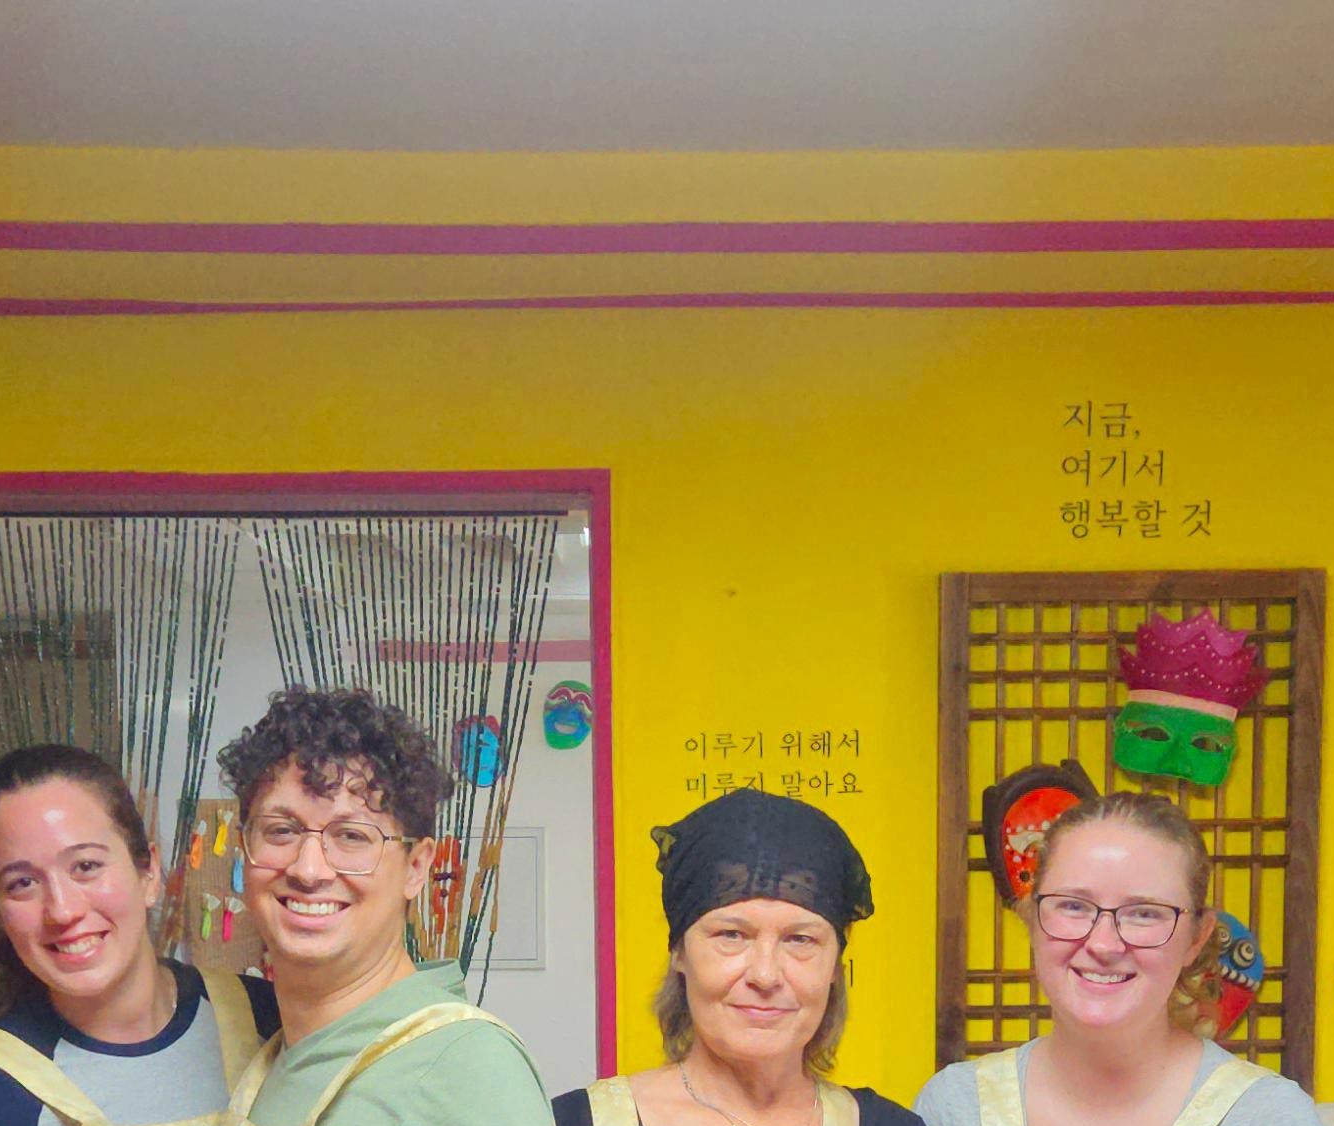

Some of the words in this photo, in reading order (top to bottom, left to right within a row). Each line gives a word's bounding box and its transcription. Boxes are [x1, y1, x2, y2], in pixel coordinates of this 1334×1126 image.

[1062, 400, 1141, 439] 지금,
[1061, 449, 1165, 487] 여기서
[1059, 499, 1168, 539] 행복할
[1181, 499, 1212, 538] 것
[684, 731, 765, 760] 이루기
[779, 729, 860, 759] 위해서
[781, 770, 864, 798] 말아요
